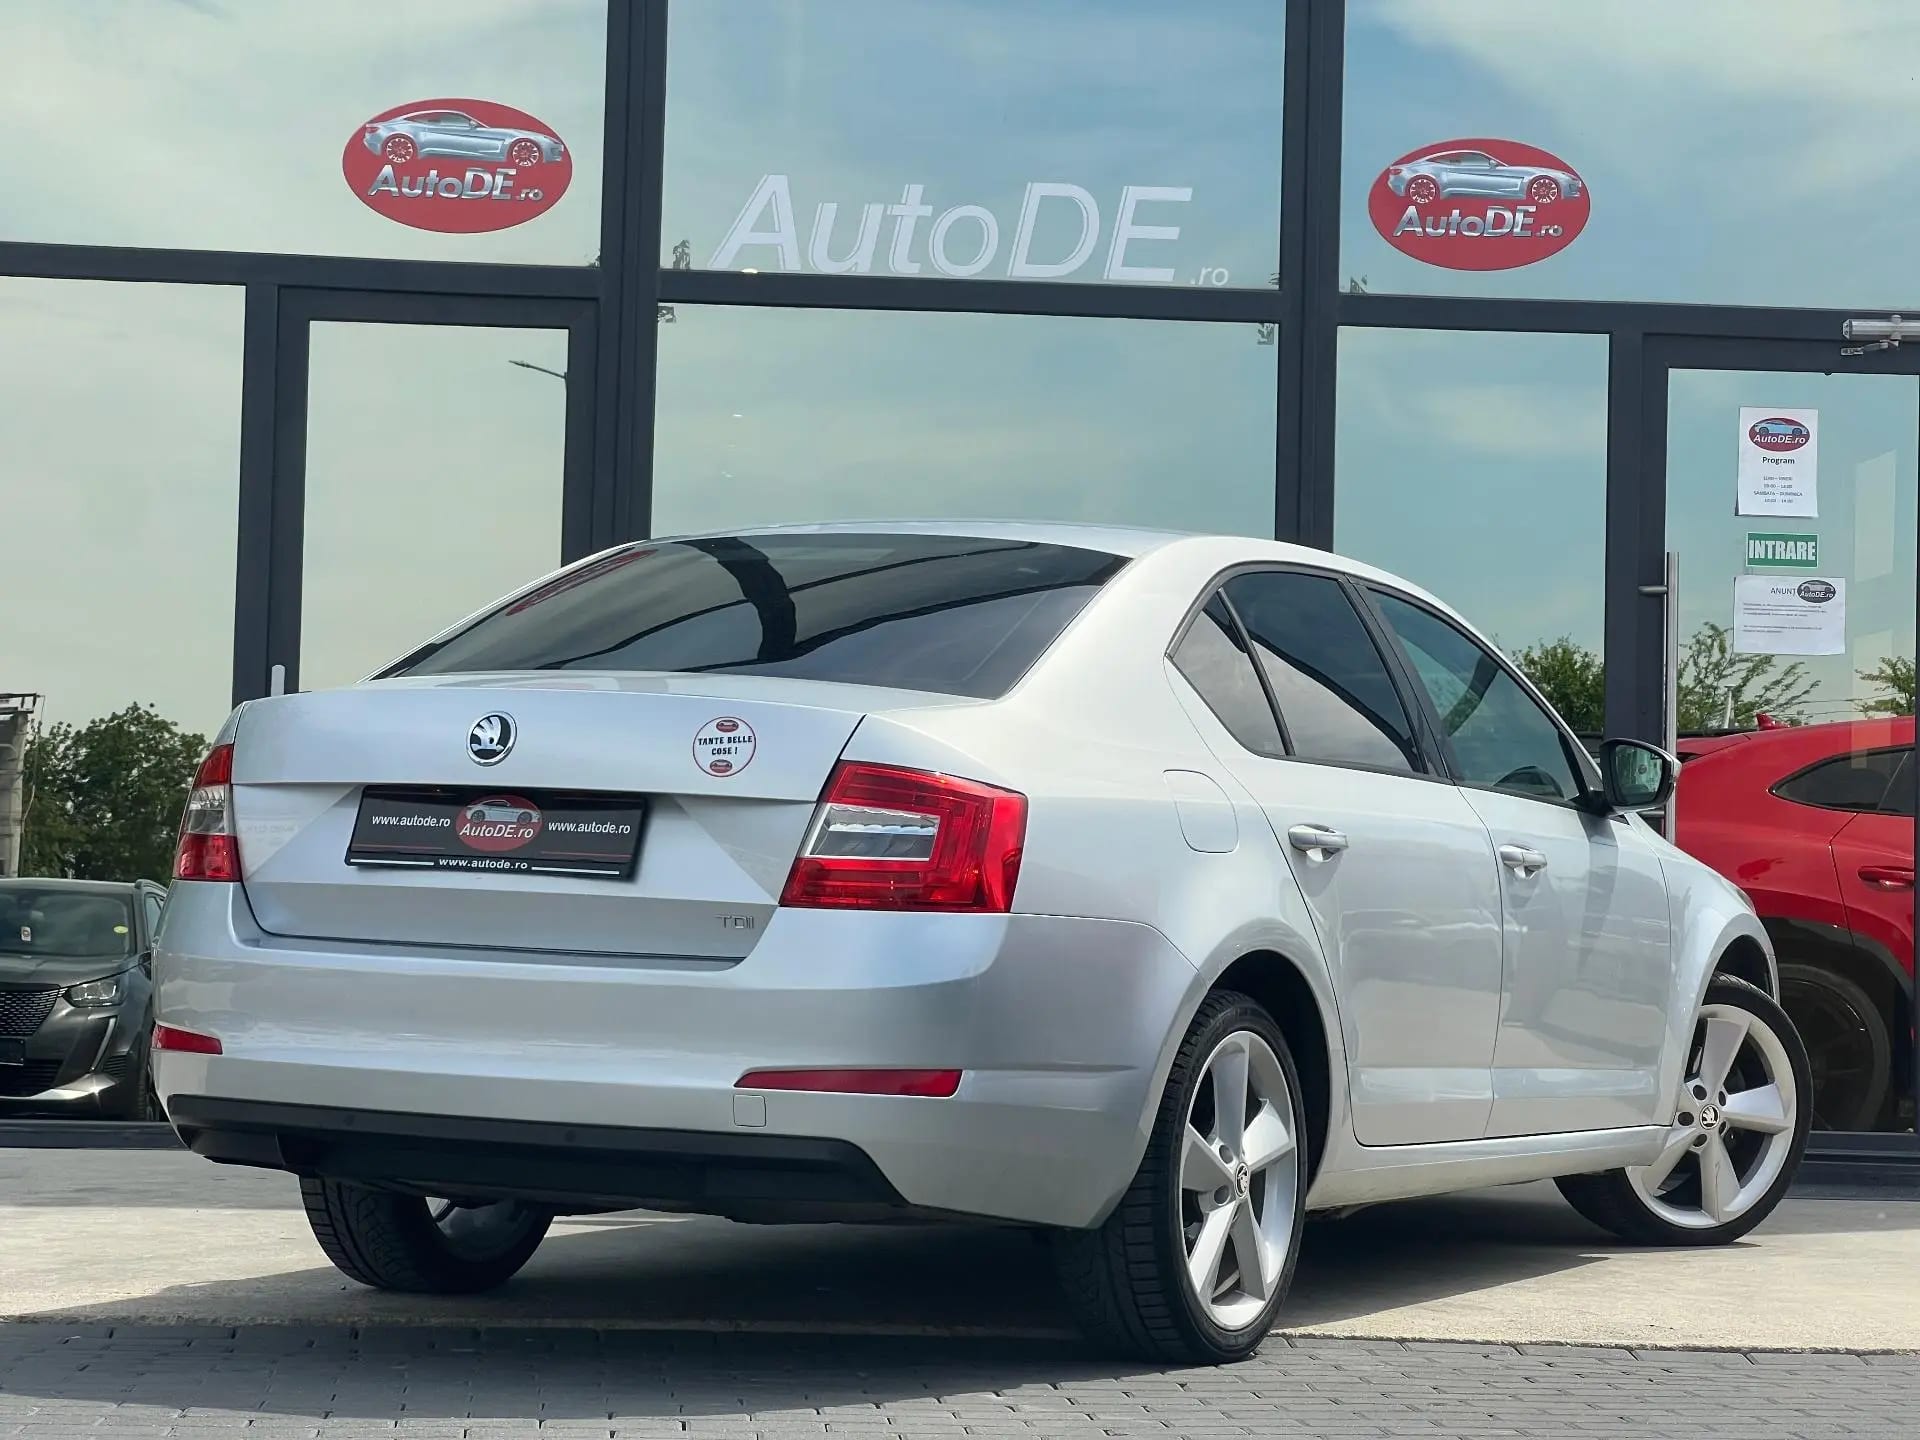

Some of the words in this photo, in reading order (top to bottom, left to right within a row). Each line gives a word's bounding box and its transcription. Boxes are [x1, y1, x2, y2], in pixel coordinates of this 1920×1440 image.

[1753, 434, 1806, 445] AutoDE.ro
[1762, 456, 1795, 465] Program
[1748, 540, 1816, 560] INTRARE
[697, 736, 725, 746] TANTE
[727, 735, 753, 744] BELLE
[711, 747, 732, 755] COSE
[371, 814, 451, 827] www.autode.ro
[458, 822, 535, 839] AutoDE.ro
[547, 821, 631, 834] www.autode.ro
[438, 857, 529, 870] www.autode.ro
[713, 914, 754, 929] TDI
